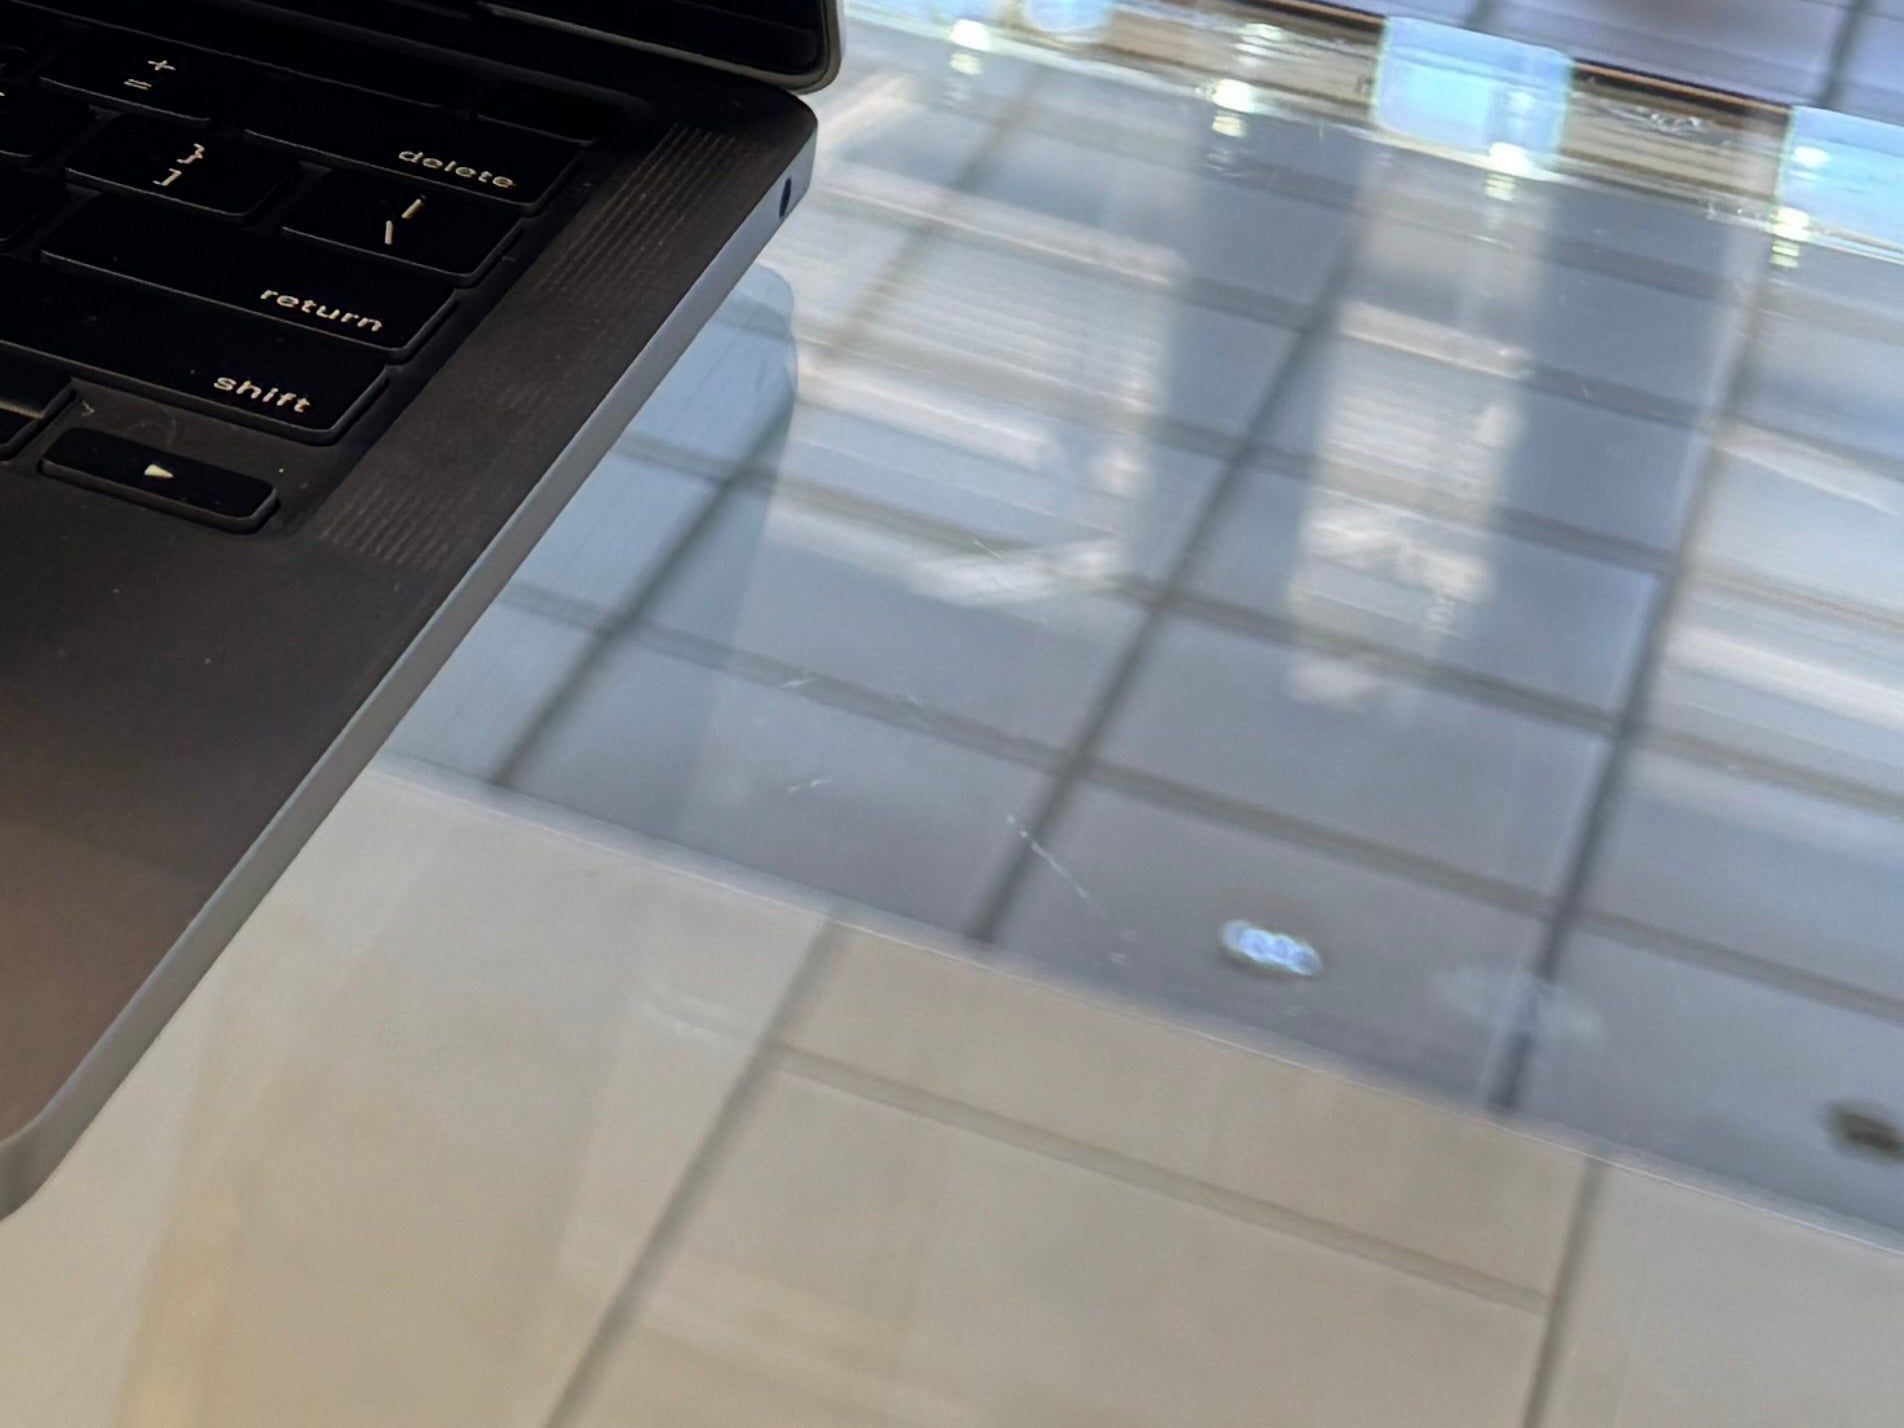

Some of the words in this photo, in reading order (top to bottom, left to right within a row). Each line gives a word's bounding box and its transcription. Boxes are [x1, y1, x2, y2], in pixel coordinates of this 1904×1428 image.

[398, 148, 516, 189] delete
[260, 287, 383, 332] return
[212, 376, 311, 413] shift
